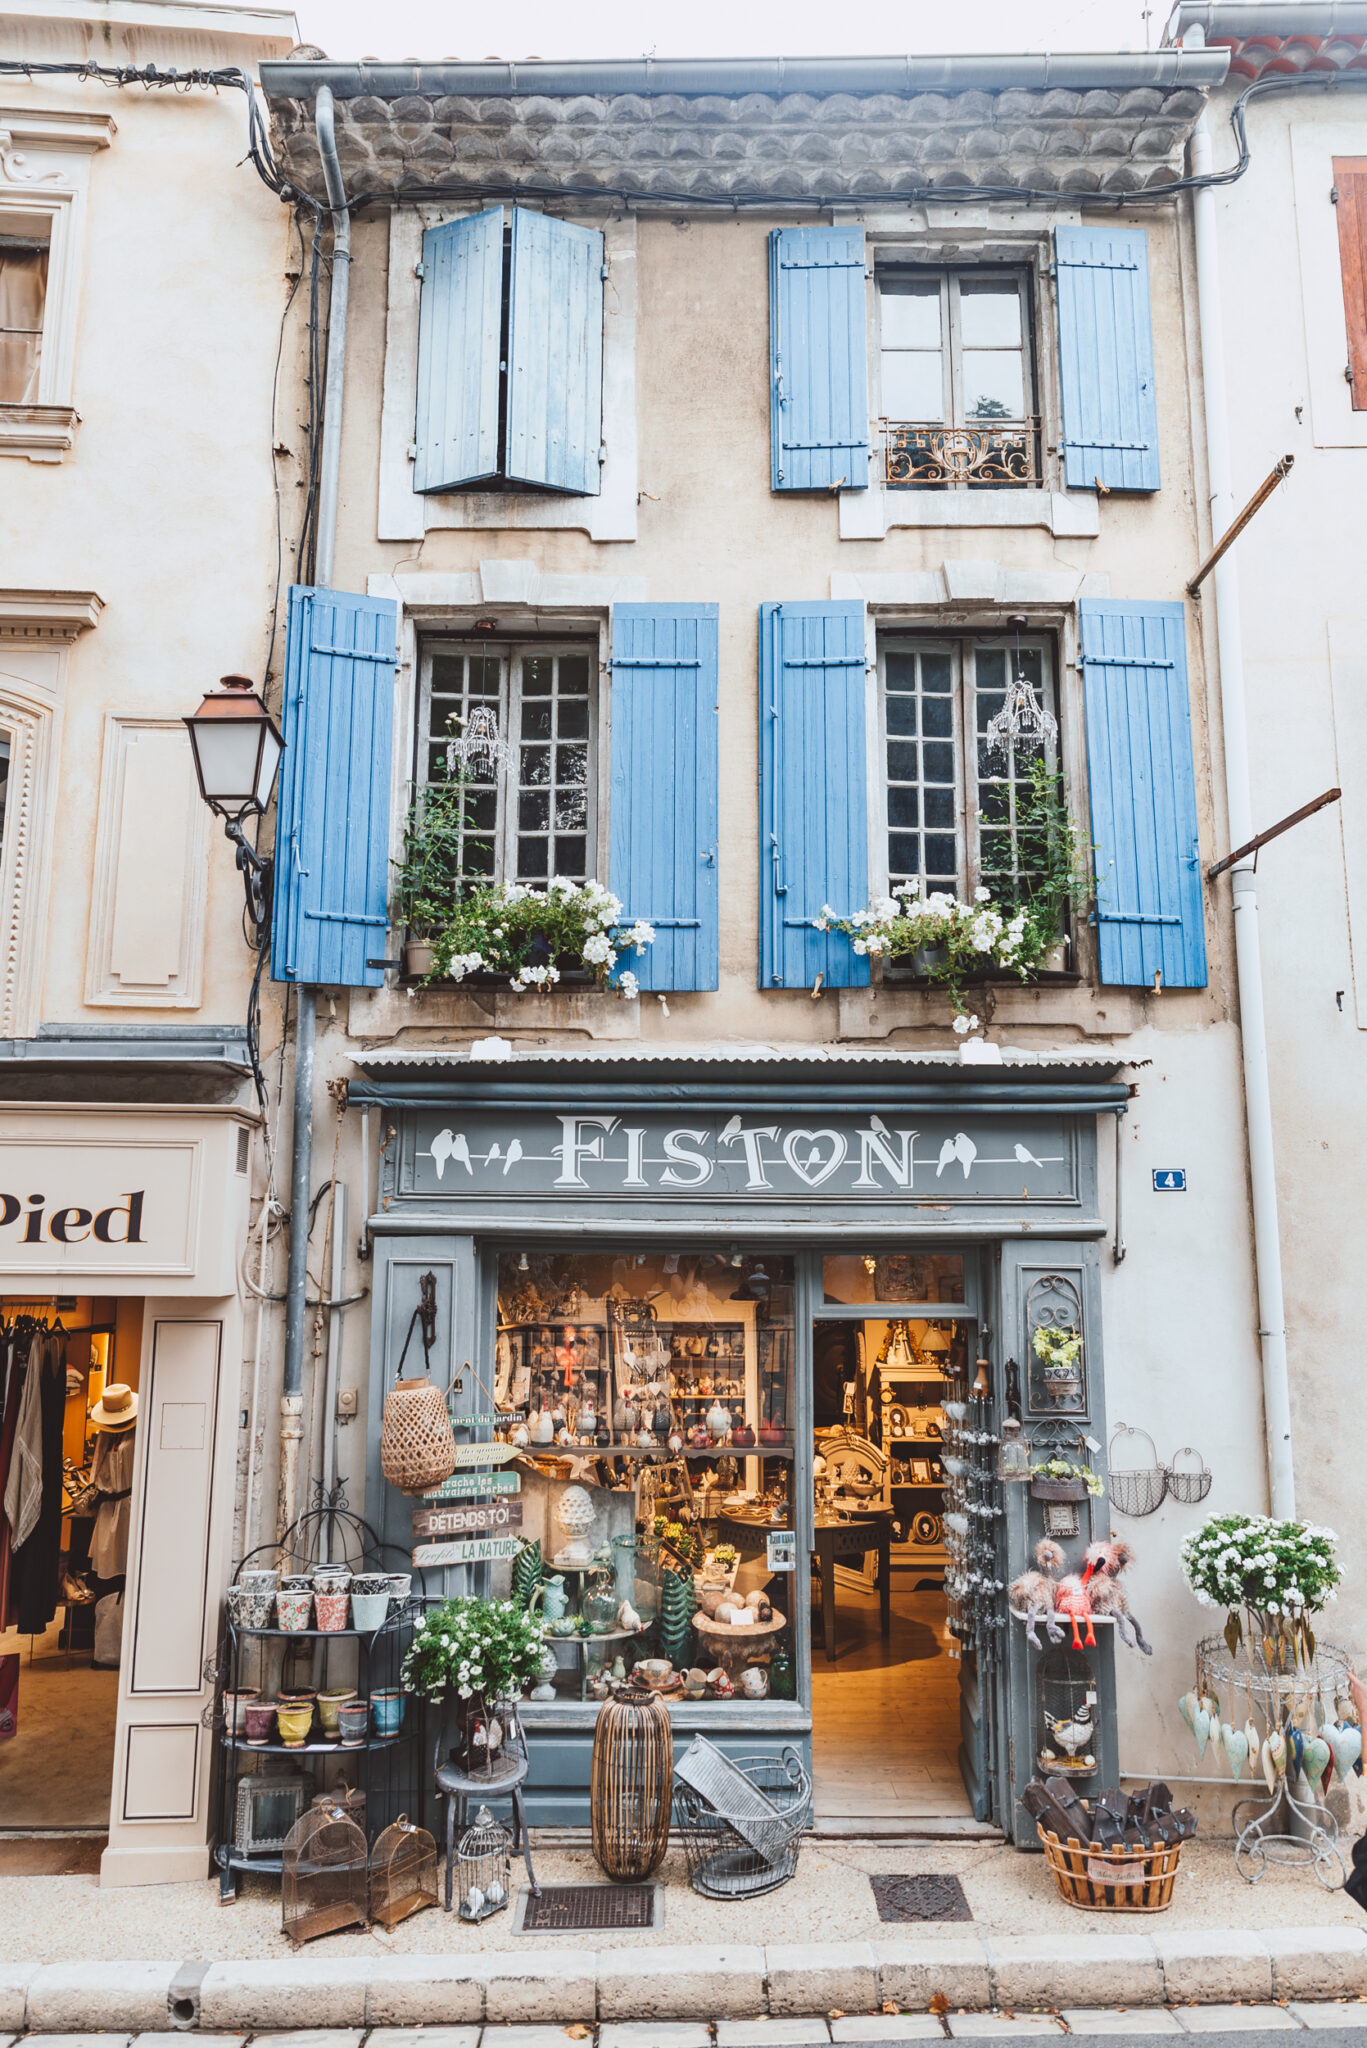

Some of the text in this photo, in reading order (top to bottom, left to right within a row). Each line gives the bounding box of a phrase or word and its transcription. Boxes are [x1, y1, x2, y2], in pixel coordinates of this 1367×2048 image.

[551, 1115, 920, 1190] FISTON
[1164, 1172, 1175, 1187] 4
[448, 1413, 522, 1425] ment du jardin
[441, 1475, 493, 1488] rrache les
[423, 1482, 514, 1499] mauvaises herbes
[462, 1543, 475, 1559] LA
[478, 1540, 518, 1556] NATURE
